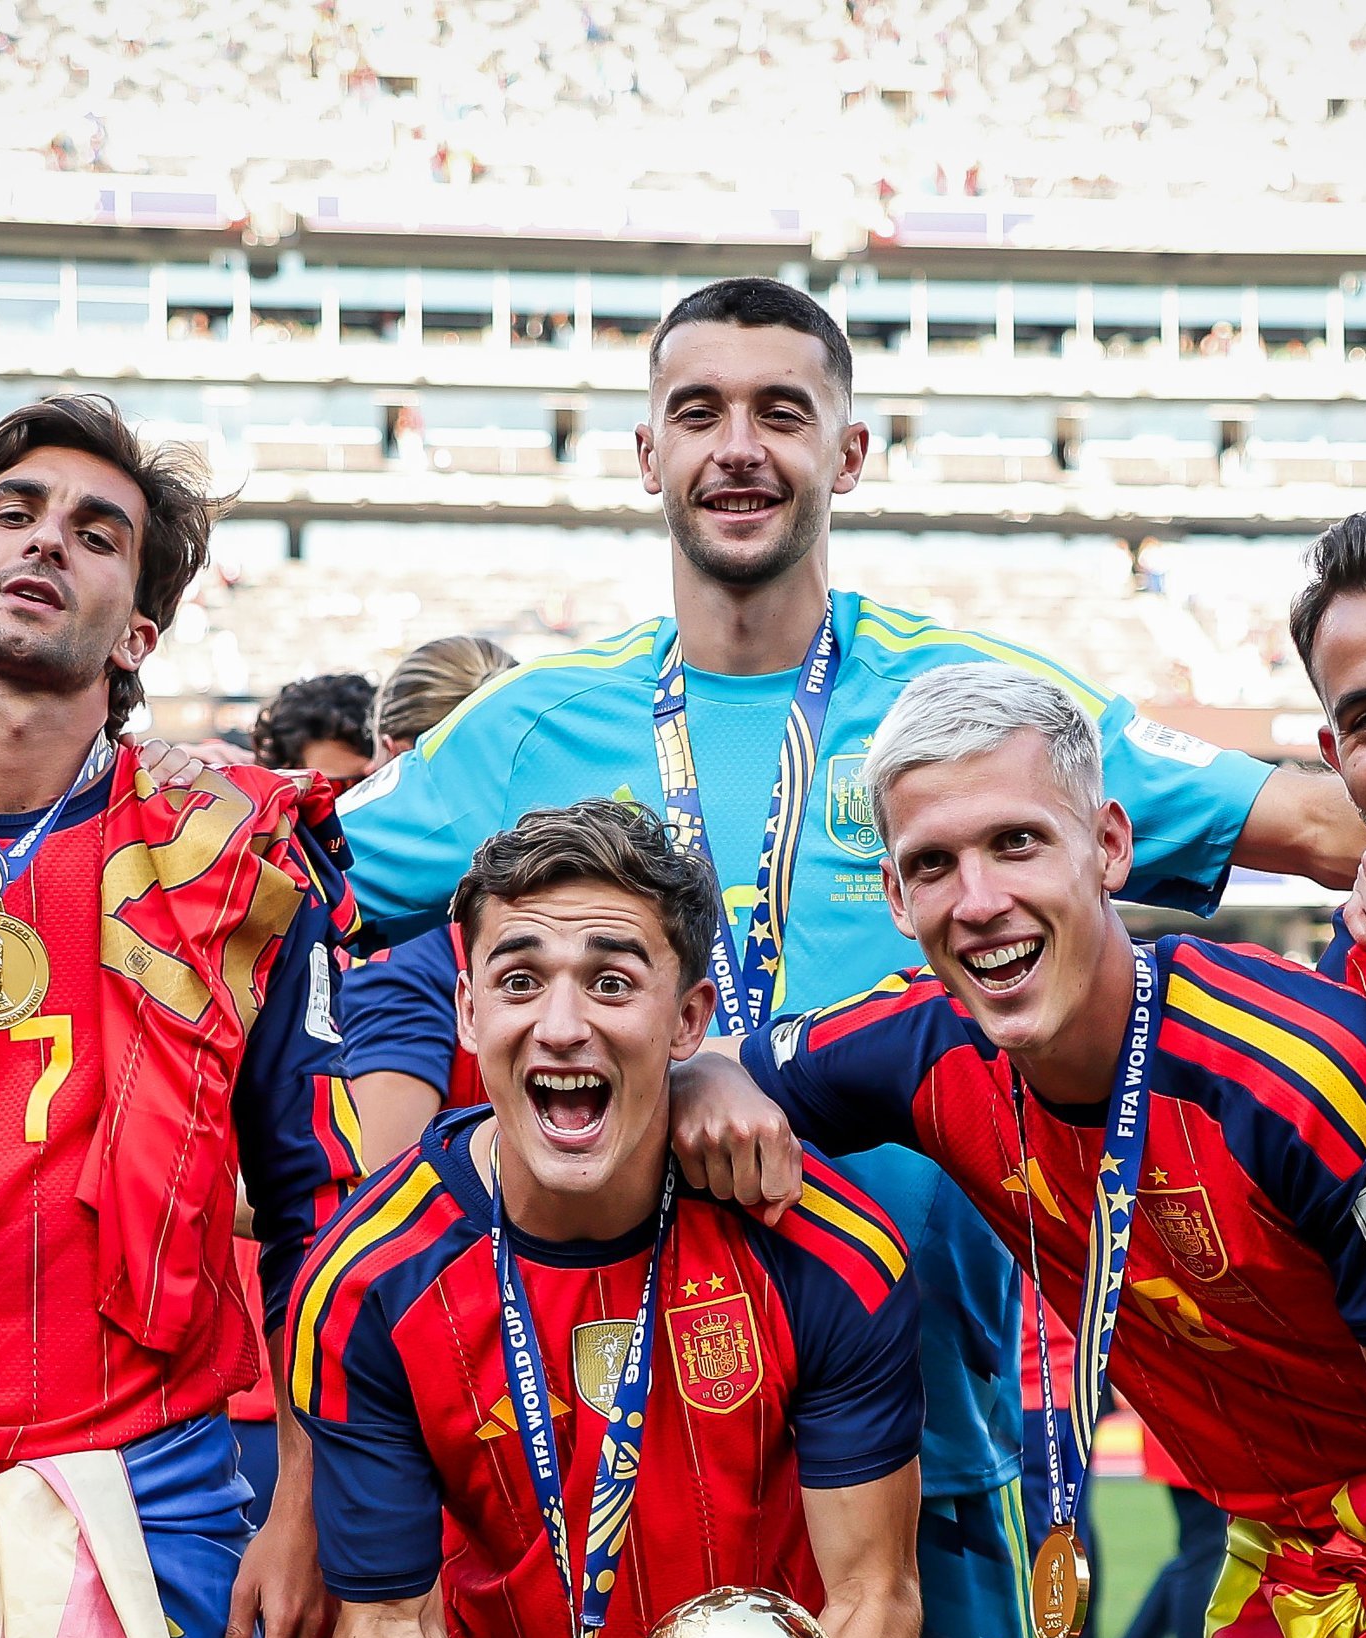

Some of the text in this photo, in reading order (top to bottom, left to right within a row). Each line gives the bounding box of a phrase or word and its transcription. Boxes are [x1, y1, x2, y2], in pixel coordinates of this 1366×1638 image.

[804, 656, 830, 694] FIFA
[711, 940, 745, 1037] WORLD CU
[1135, 958, 1153, 1003] CUP
[10, 1014, 74, 1143] 7
[1124, 1004, 1150, 1090] WORLD
[1116, 1090, 1141, 1139] FIFA
[504, 1305, 526, 1350] CUP
[624, 1307, 648, 1386] 2026
[517, 1350, 543, 1431] WORLD
[530, 1430, 553, 1479] FIFA
